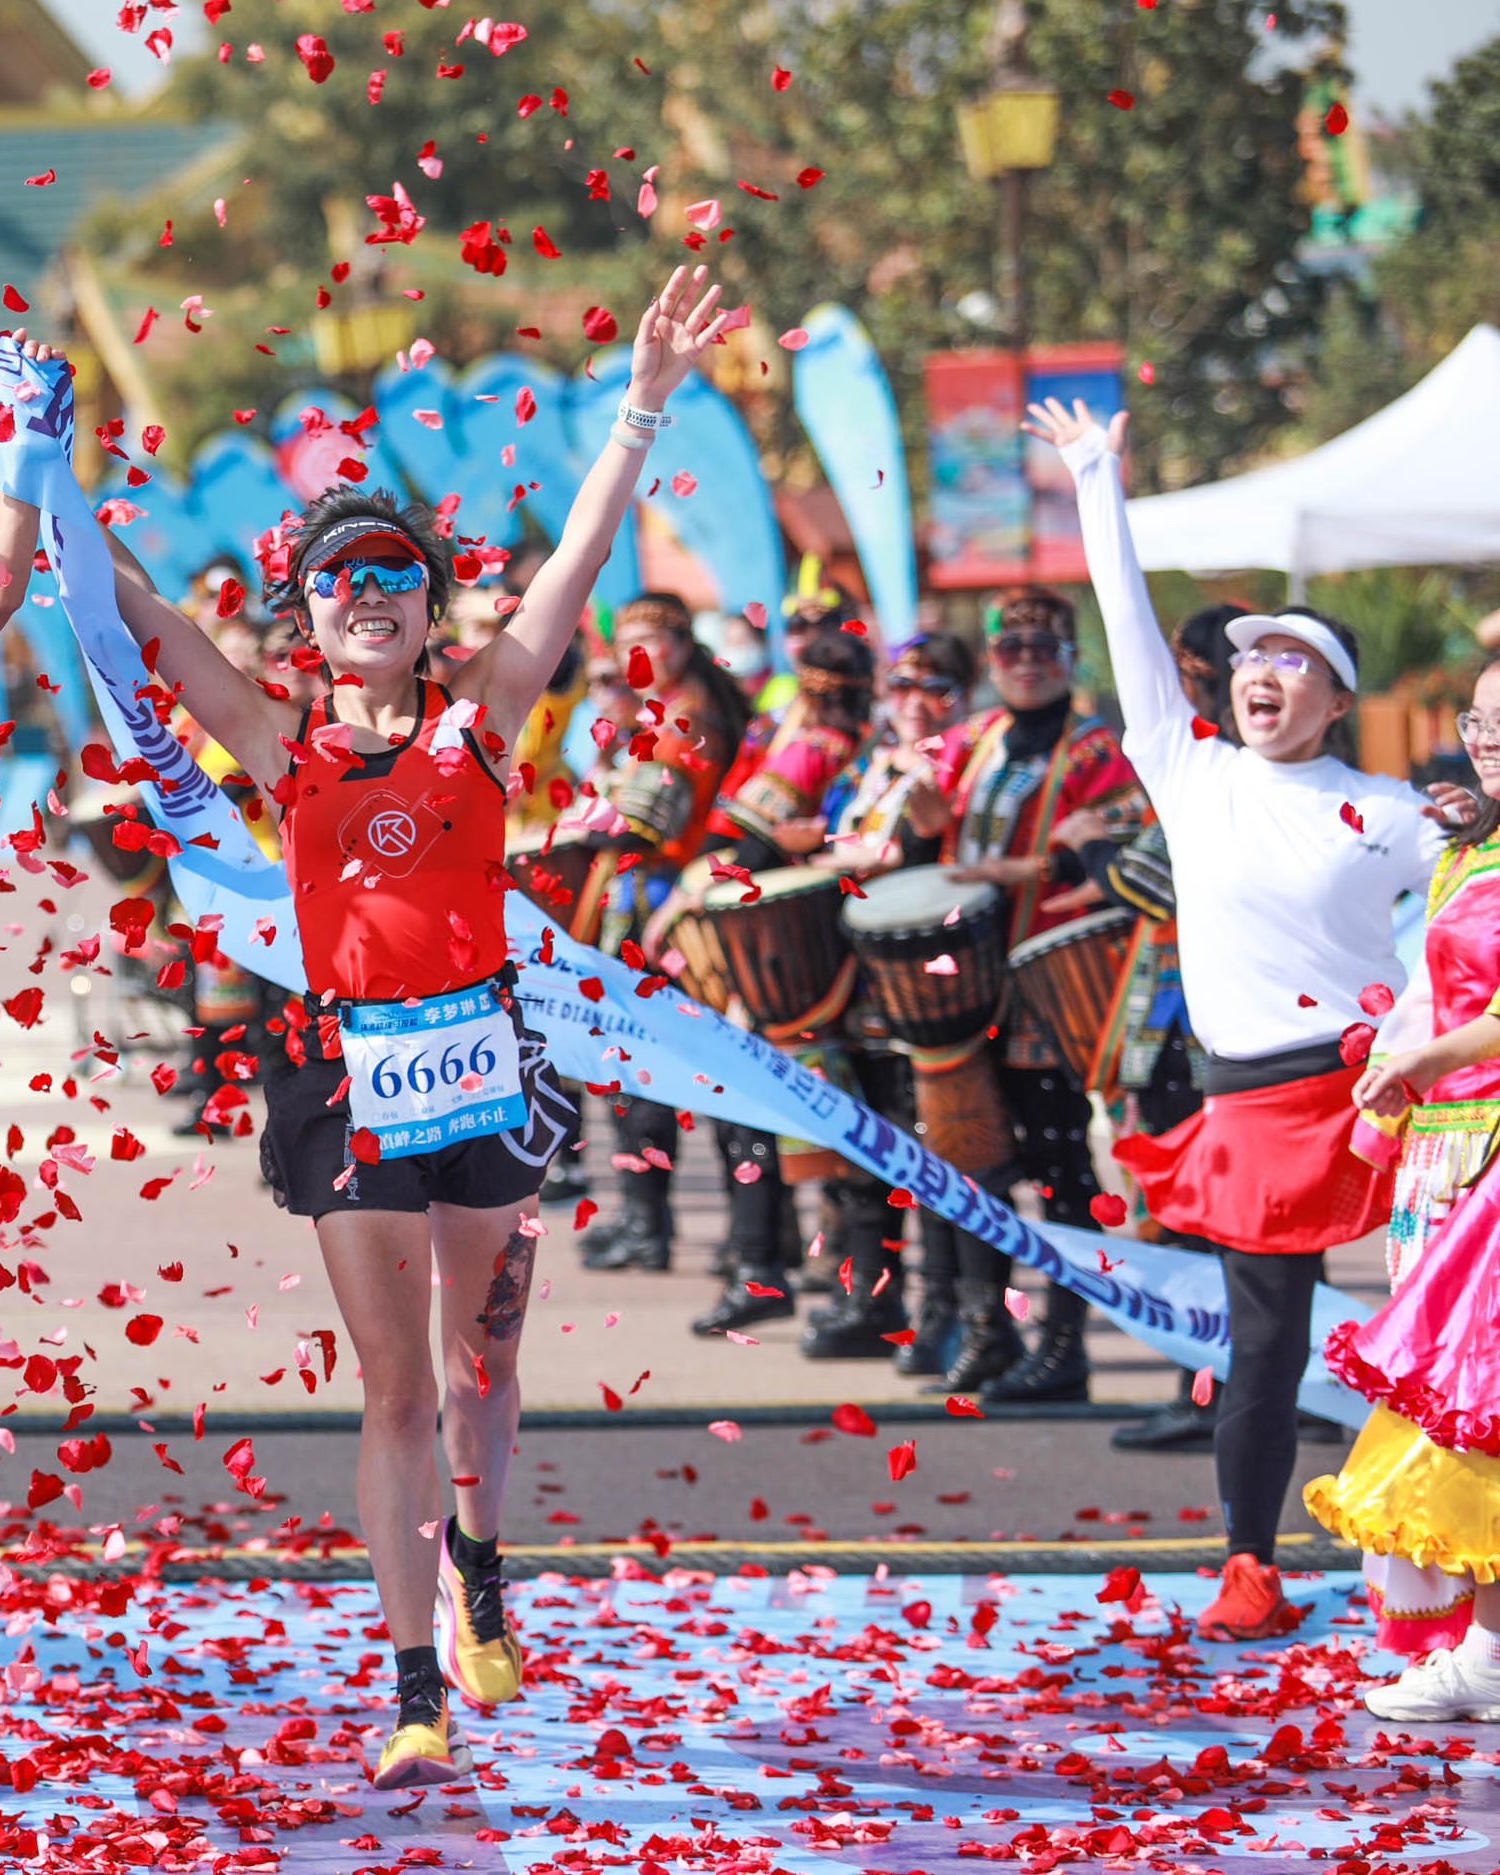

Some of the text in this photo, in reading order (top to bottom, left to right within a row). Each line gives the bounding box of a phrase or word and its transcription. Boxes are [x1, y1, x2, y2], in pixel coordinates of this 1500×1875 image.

[424, 998, 477, 1024] 李梦琳
[371, 1034, 496, 1099] 6666
[449, 1106, 509, 1136] 奔跑不止
